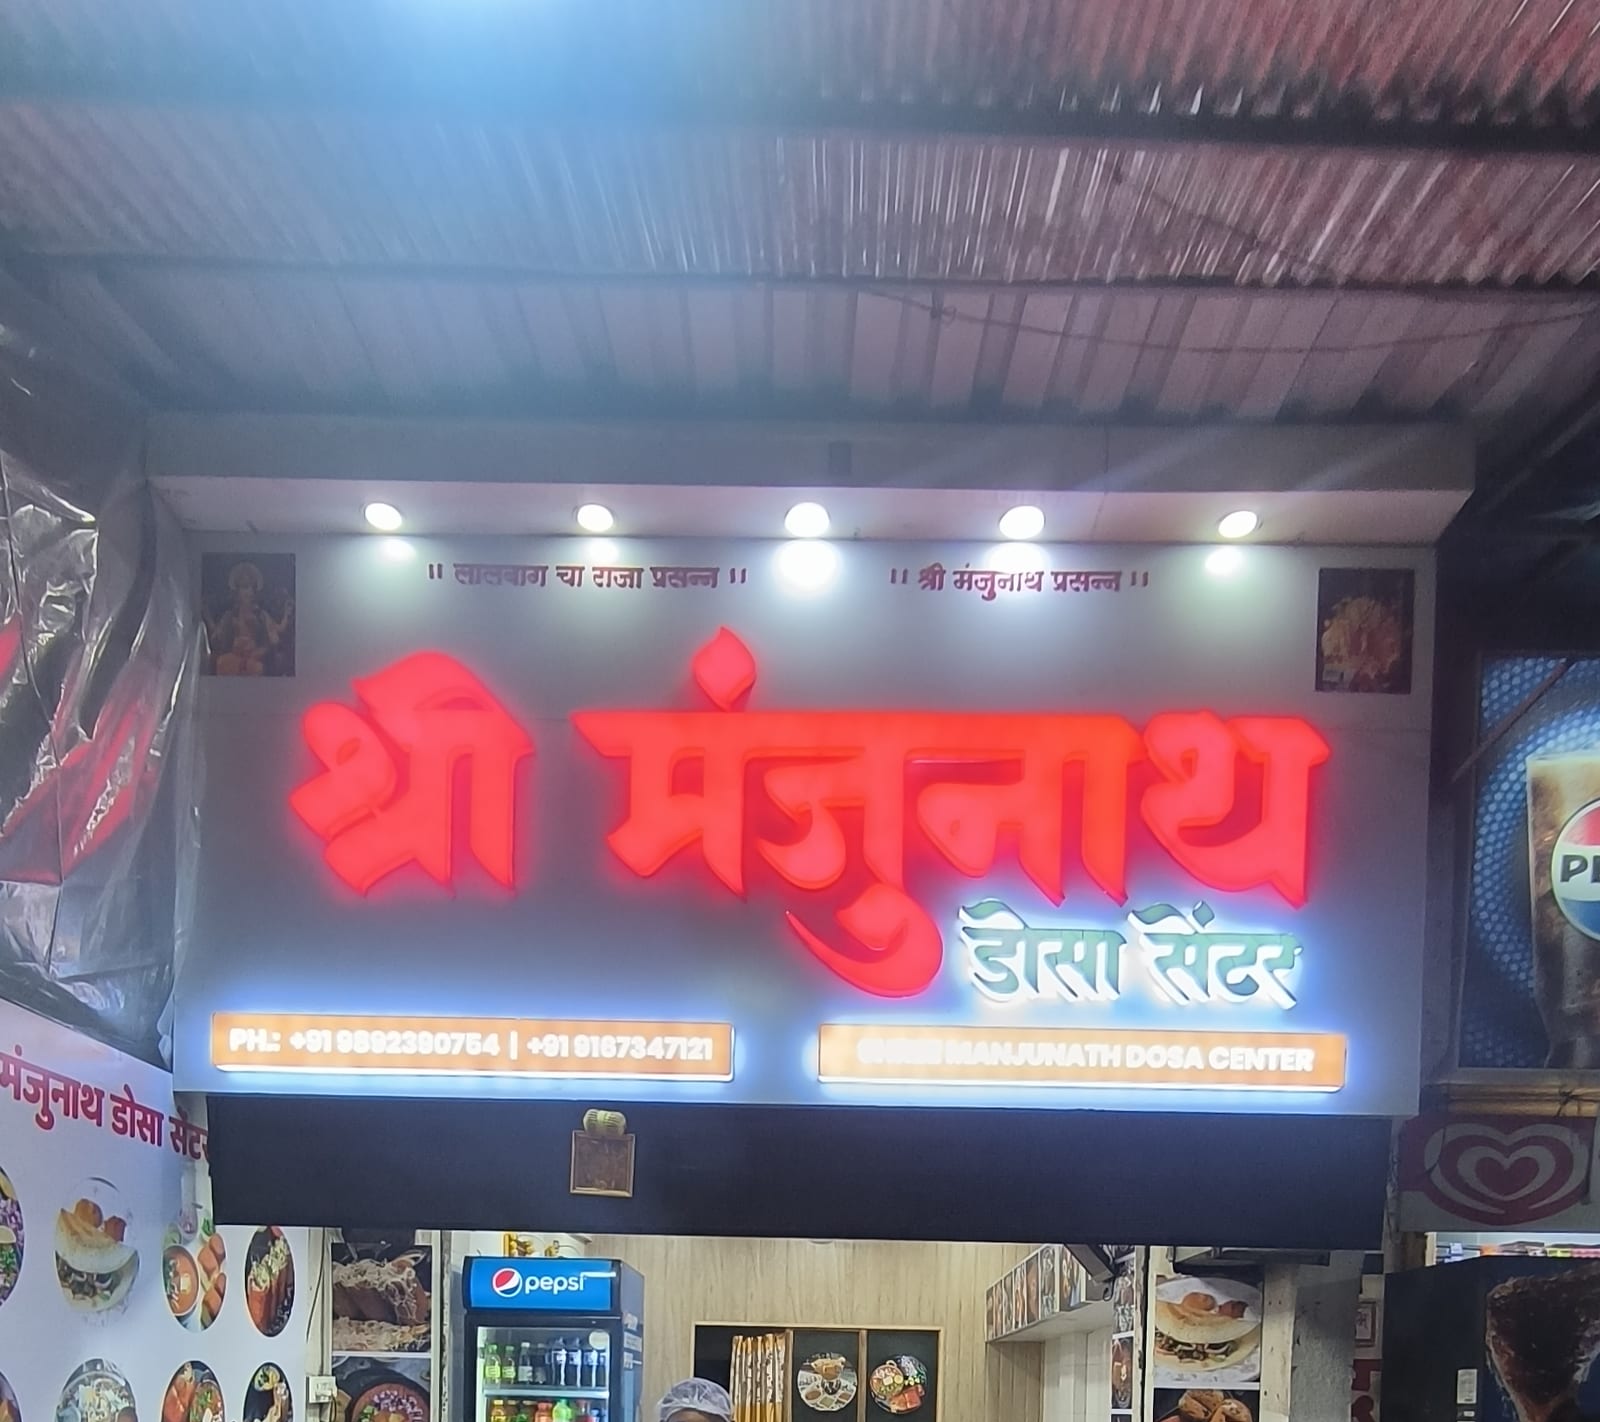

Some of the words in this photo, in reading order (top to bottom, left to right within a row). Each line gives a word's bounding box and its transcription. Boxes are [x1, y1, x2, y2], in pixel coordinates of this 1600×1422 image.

[555, 565, 586, 588] चा
[592, 566, 645, 589] राजा
[649, 566, 720, 589] प्रसन्न
[917, 562, 947, 592] श्री
[952, 562, 1045, 602] मंजुनाथ
[1050, 570, 1122, 593] प्रसन्न
[289, 649, 538, 898] श्री
[569, 625, 1333, 1001] मंजुनाथ
[957, 897, 1128, 1003] डोसा
[1126, 900, 1303, 1010] सेंटर
[945, 1040, 1121, 1069] MANJUNATH
[1125, 1045, 1205, 1071] DOSA
[1207, 1046, 1316, 1072] CENTER
[0, 1044, 105, 1130] मंजुनाथ
[110, 1083, 165, 1148] डोसा
[524, 1271, 585, 1295] pepsi
